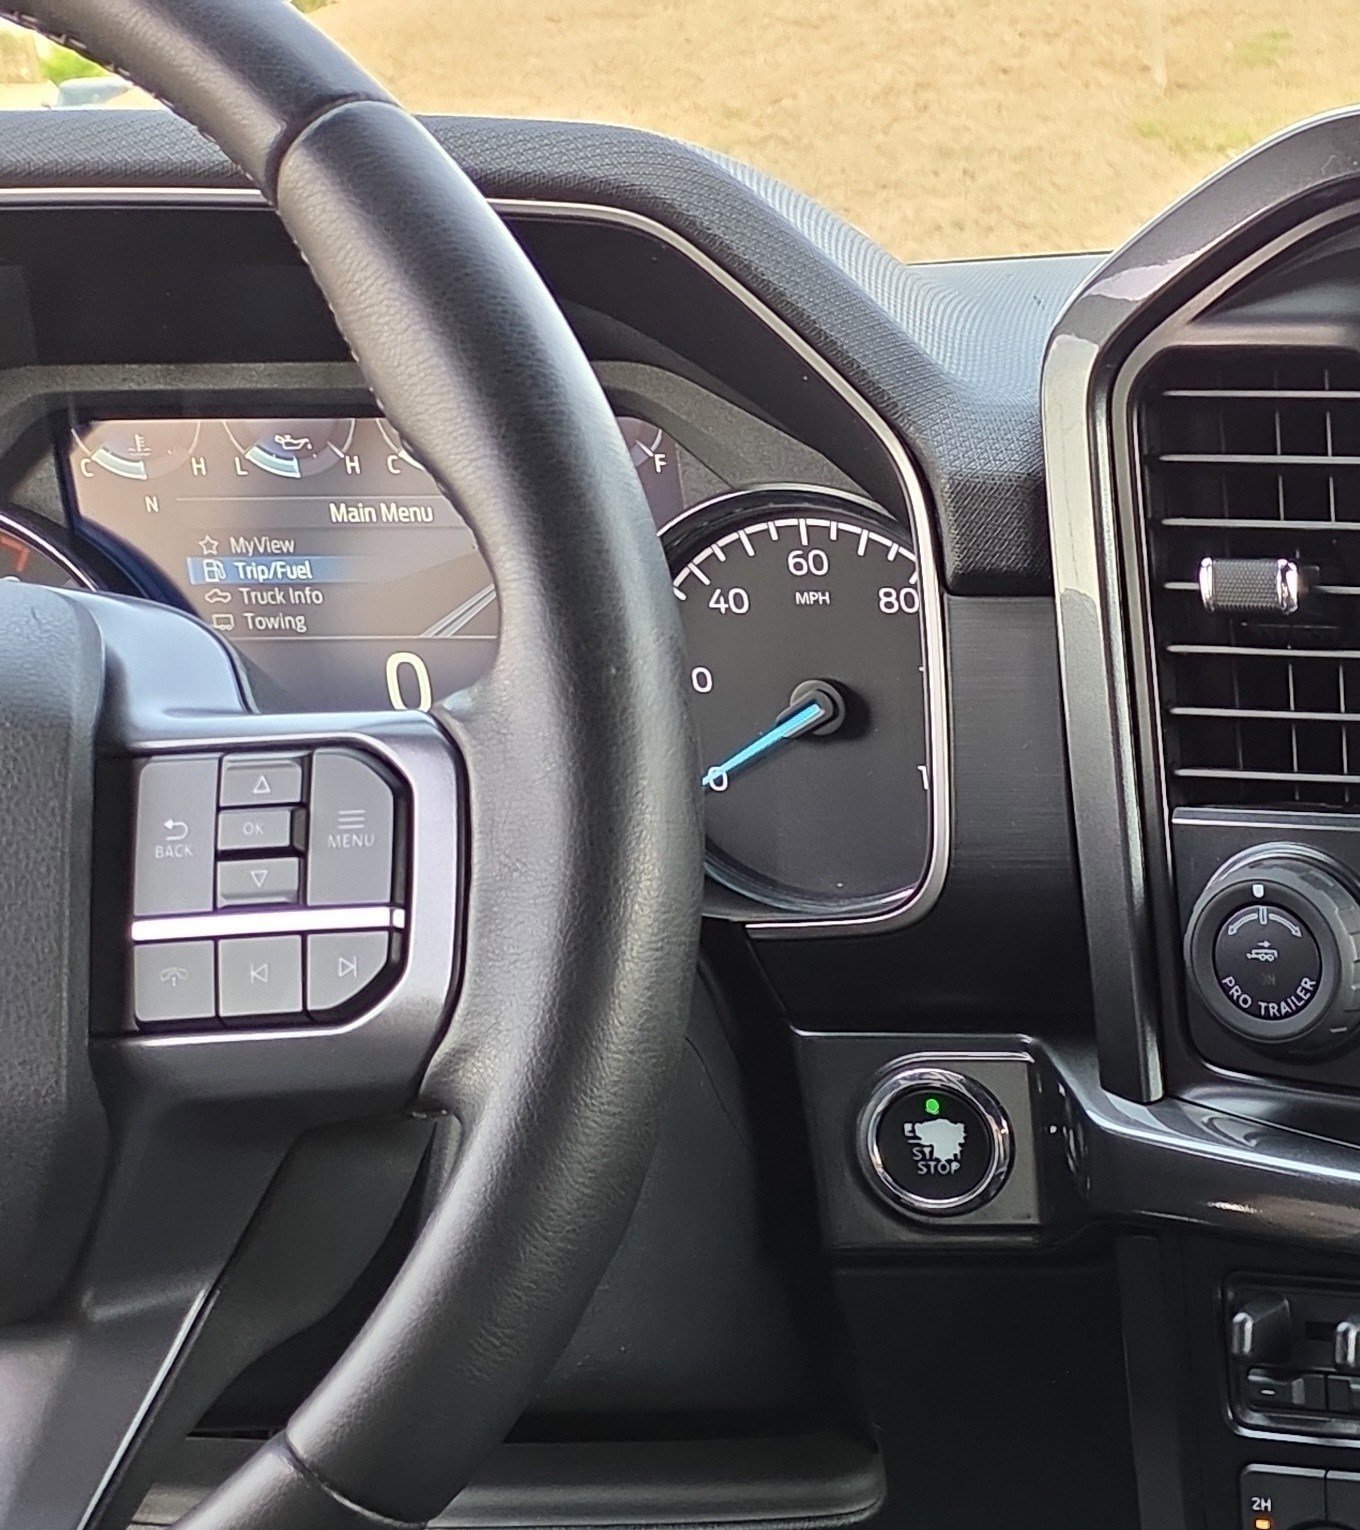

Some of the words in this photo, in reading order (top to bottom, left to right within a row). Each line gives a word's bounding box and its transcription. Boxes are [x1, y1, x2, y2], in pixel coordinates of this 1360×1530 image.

[80, 457, 95, 478] C
[192, 457, 206, 476] H
[236, 456, 249, 476] L
[346, 454, 361, 475] H
[387, 454, 401, 474] C
[653, 453, 668, 473] F
[145, 496, 159, 513] N
[329, 502, 379, 523] Main
[380, 501, 434, 523] Menu
[230, 536, 295, 556] MyView
[235, 561, 313, 582] Trip/Fuel
[787, 549, 829, 577] 60
[240, 587, 287, 606] Truck
[289, 587, 324, 606] Info
[708, 587, 750, 614] 40
[795, 591, 831, 607] MPH
[878, 587, 920, 614] 80
[244, 612, 307, 632] Towing
[385, 651, 432, 713] 0
[691, 666, 713, 693] 0
[243, 820, 264, 837] OK
[327, 831, 375, 849] MENU
[154, 843, 194, 860] BACK
[1221, 975, 1253, 1010] PRO
[1257, 975, 1317, 1018] TRAILER
[917, 1160, 961, 1175] STOP
[1251, 1496, 1272, 1512] 2H
